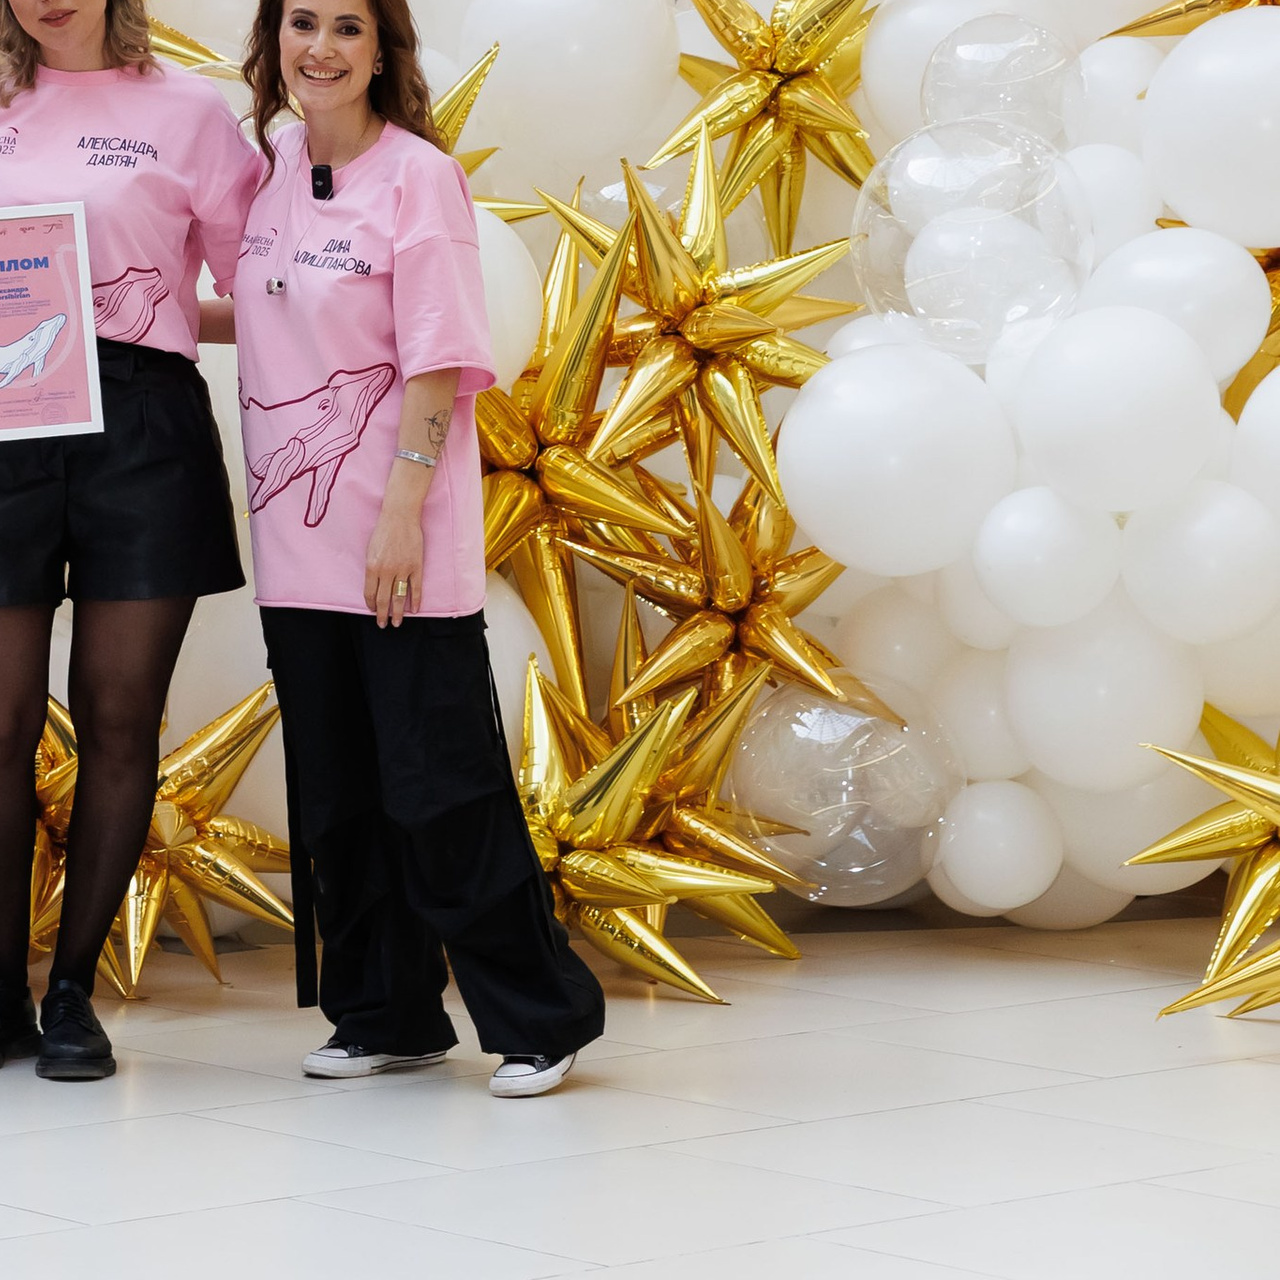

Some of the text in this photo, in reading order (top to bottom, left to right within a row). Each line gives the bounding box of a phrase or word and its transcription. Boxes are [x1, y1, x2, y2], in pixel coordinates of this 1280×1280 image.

[77, 137, 159, 162] АЛЕКСАНДРА
[86, 153, 138, 169] ДАВТЯН
[251, 245, 271, 257] 2025
[322, 239, 352, 254] ДИНА
